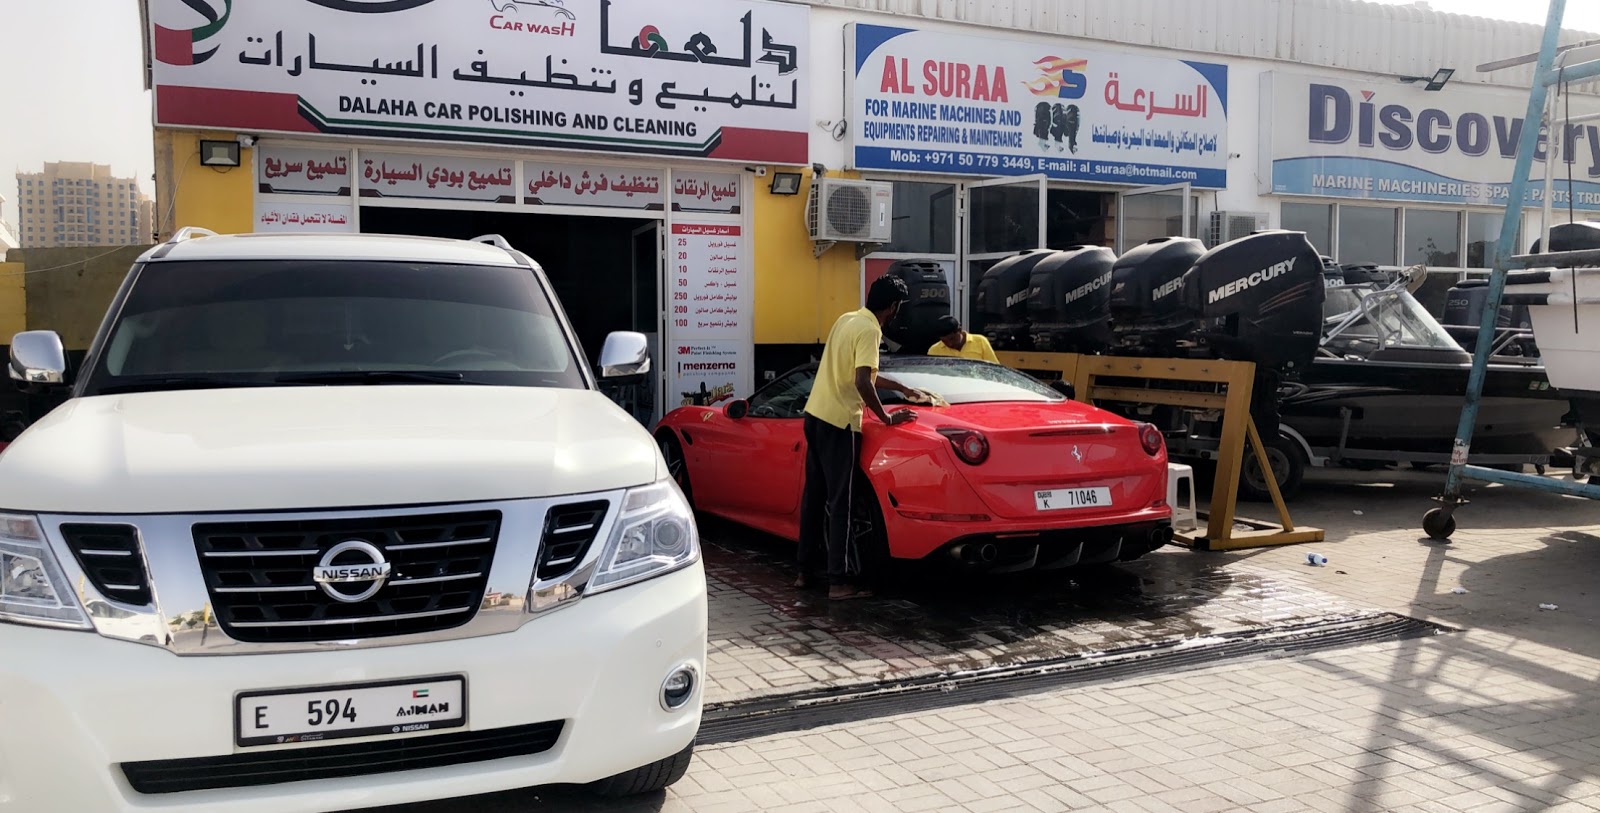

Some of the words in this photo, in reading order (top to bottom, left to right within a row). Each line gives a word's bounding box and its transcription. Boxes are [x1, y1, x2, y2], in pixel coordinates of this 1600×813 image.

[239, 30, 437, 86] السيارات
[880, 55, 915, 94] AL
[923, 59, 1009, 103] SURAA
[656, 74, 797, 112] لتلميع
[1104, 72, 1207, 121] السرعة
[339, 96, 418, 117] DALAHA
[424, 102, 462, 120] CAR
[468, 105, 567, 127] POLISHING
[572, 113, 608, 130] AND
[613, 116, 697, 137] CLEANING
[865, 98, 888, 117] FOR
[892, 101, 936, 120] MARINE
[940, 105, 996, 125] MACHINES
[999, 110, 1021, 126] AND
[864, 121, 915, 141] EQUIPMENTS
[917, 125, 960, 144] REPAIRING
[962, 130, 968, 144] &
[969, 129, 1022, 148] MAINTENANCE
[265, 156, 302, 178] سريع
[306, 156, 347, 180] تلميع
[364, 159, 422, 185] السيارة
[890, 150, 921, 163] Mob:
[924, 152, 954, 165] +971
[958, 154, 973, 166] 50
[977, 155, 999, 168] 779
[1002, 157, 1034, 170] 3449,
[1038, 160, 1077, 172] E-mail:
[1080, 161, 1197, 180] al_suraa@hotmail.com
[426, 166, 464, 188] بودي
[468, 168, 512, 190] تلميع
[529, 170, 571, 194] داخلي
[575, 171, 608, 195] فرش
[611, 174, 659, 197] تنظيف
[1312, 174, 1373, 191] MARINE
[1378, 178, 1480, 198] MACHINERIES
[674, 179, 709, 200] الرنقات
[711, 181, 736, 202] تلميع
[677, 238, 687, 246] 25
[678, 252, 687, 260] 20
[678, 265, 687, 273] 10
[678, 279, 688, 287] 50
[1208, 257, 1297, 304] MERCURY
[674, 292, 688, 300] 250
[920, 288, 946, 298] 300
[674, 305, 688, 313] 200
[675, 319, 688, 327] 100
[678, 346, 690, 354] 3M
[683, 362, 735, 370] menzerna
[1043, 499, 1050, 508] K
[1068, 490, 1097, 505] 71046
[322, 567, 382, 579] NISSAN
[255, 706, 269, 728] E
[307, 697, 357, 726] 594
[402, 723, 429, 731] NISSAN
